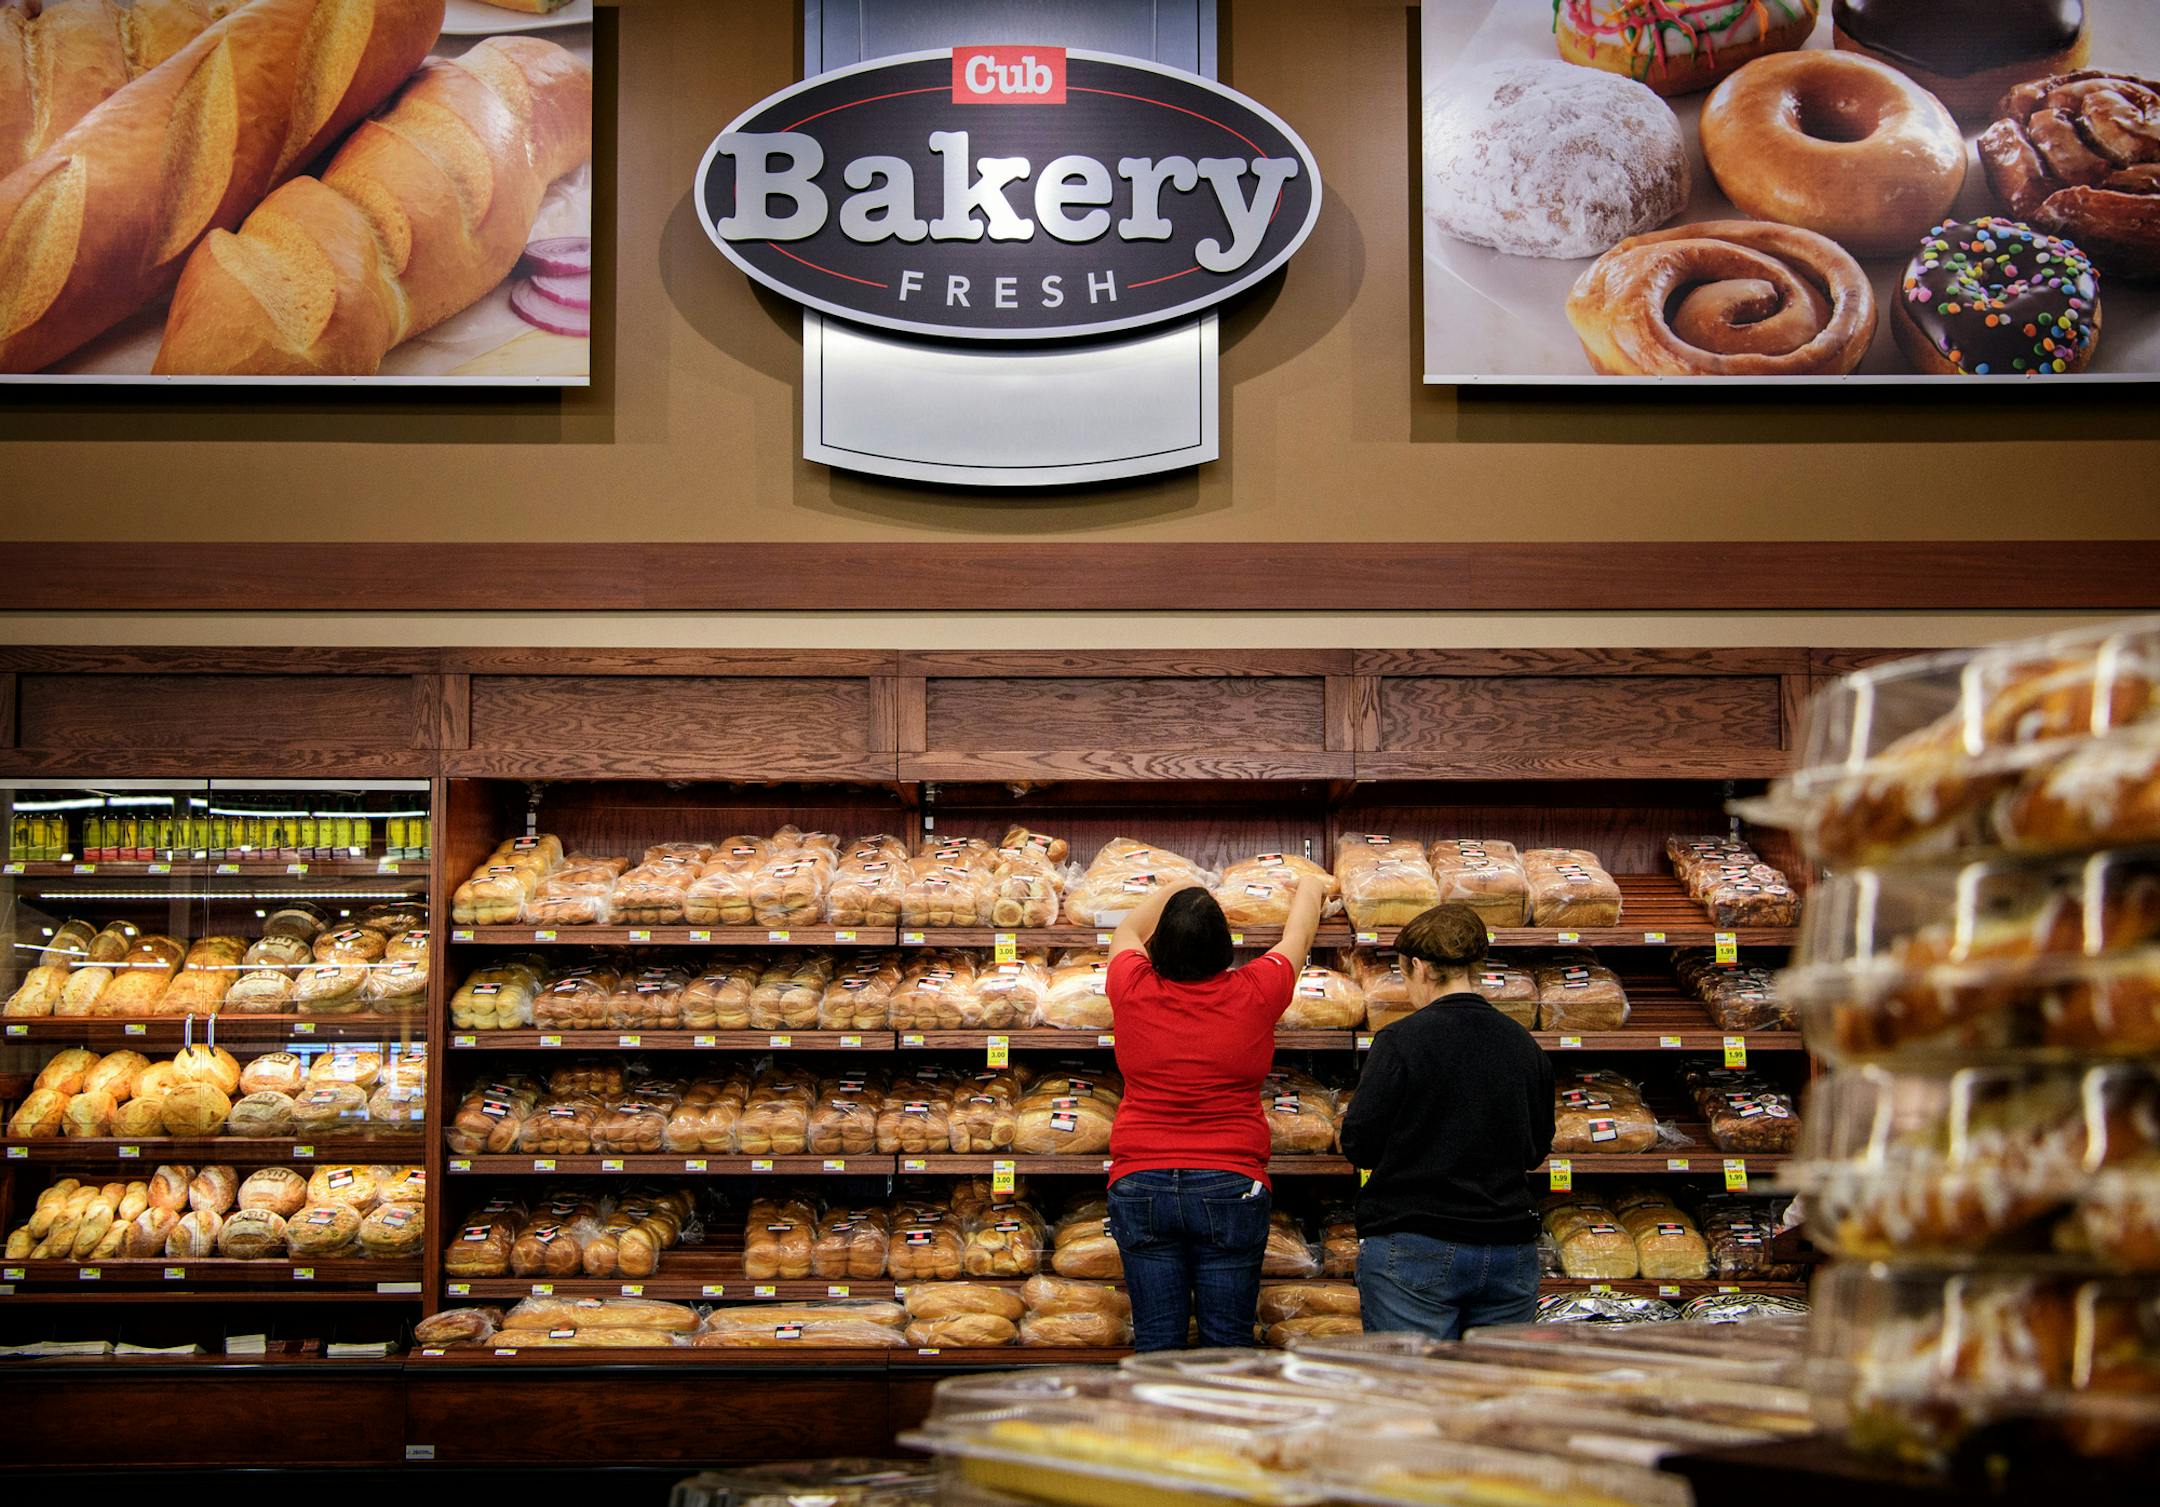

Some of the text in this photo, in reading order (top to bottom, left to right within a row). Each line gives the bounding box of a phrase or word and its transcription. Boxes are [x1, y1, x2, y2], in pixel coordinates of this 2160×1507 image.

[965, 55, 1053, 96] Cub
[717, 130, 1299, 274] Bakery
[899, 270, 1119, 308] FRESH
